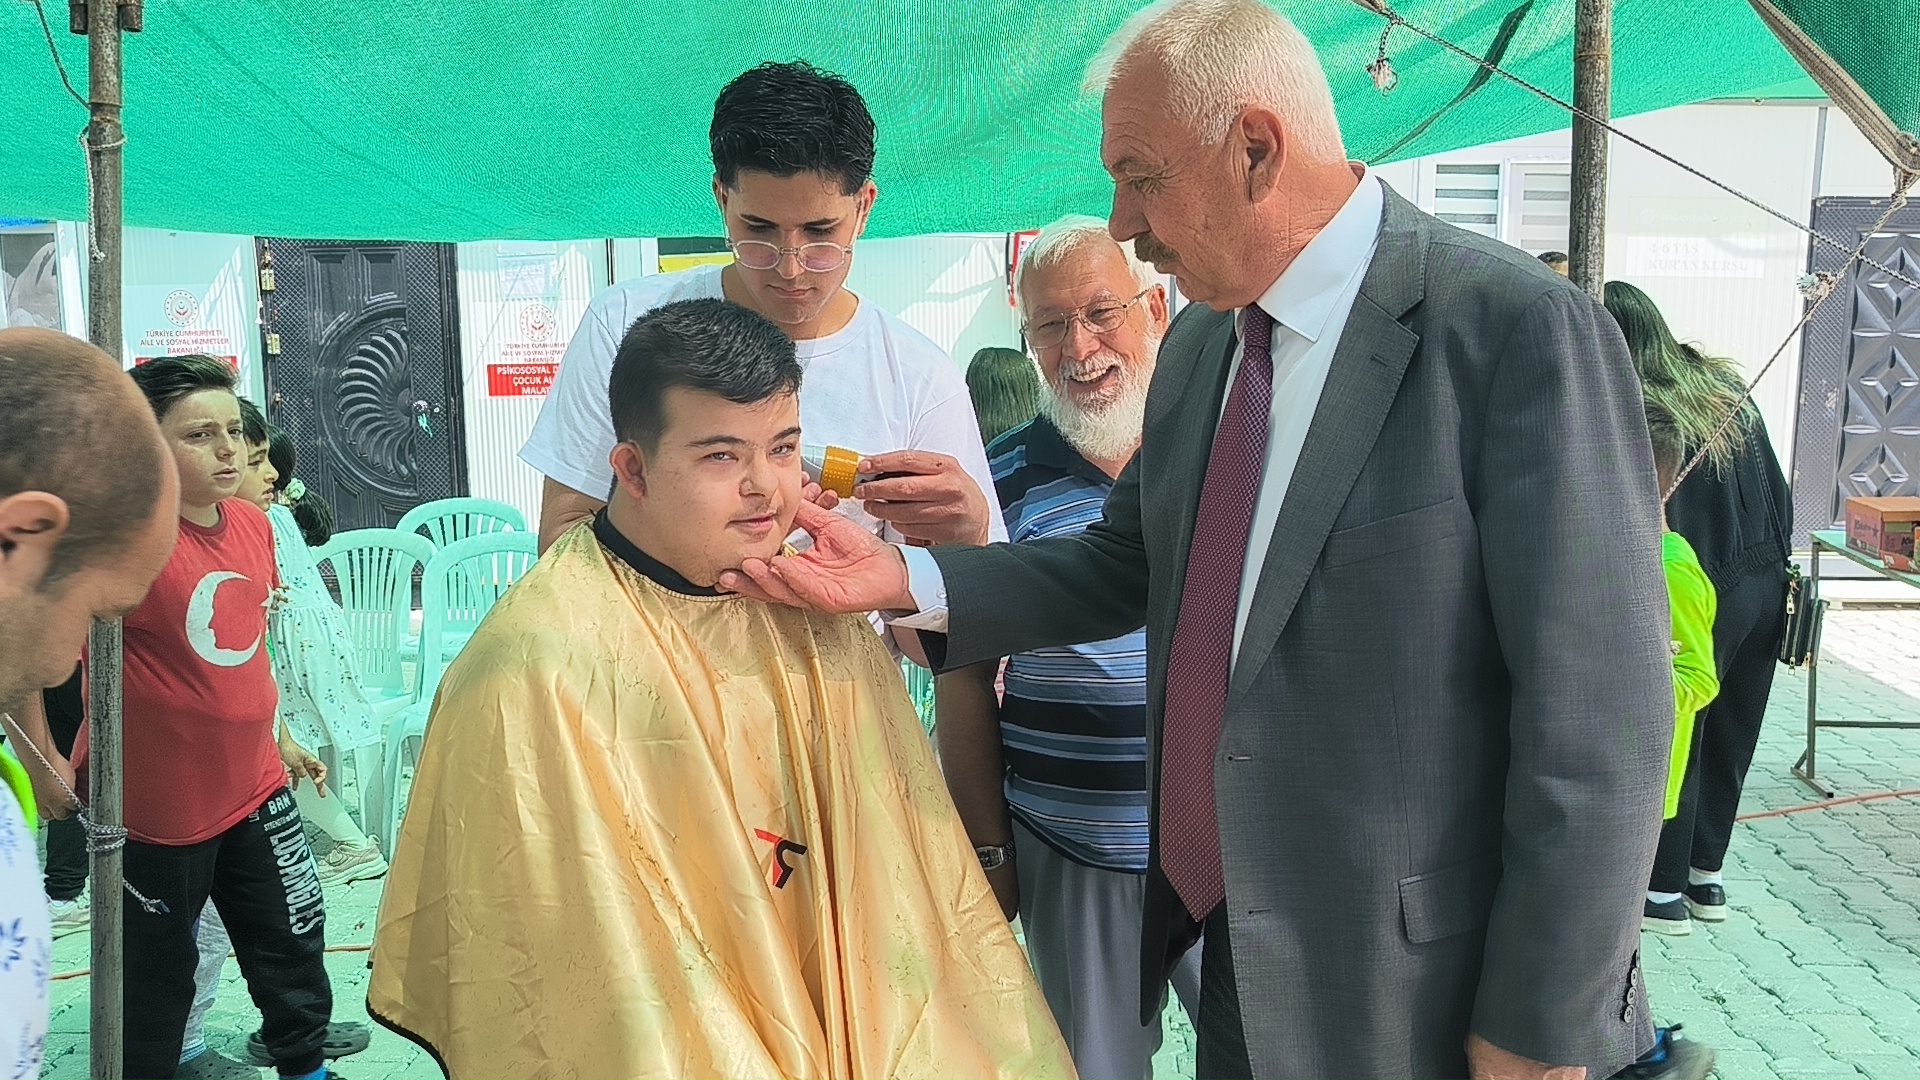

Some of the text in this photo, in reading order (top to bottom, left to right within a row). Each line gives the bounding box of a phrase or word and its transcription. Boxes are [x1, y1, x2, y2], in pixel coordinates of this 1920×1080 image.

[1702, 259, 1749, 272] KURSU
[145, 329, 174, 337] TÜRKİYE
[166, 338, 190, 346] SOSYAL
[496, 365, 551, 375] PSİKOSOSYAL
[512, 376, 541, 386] ÇOCUK
